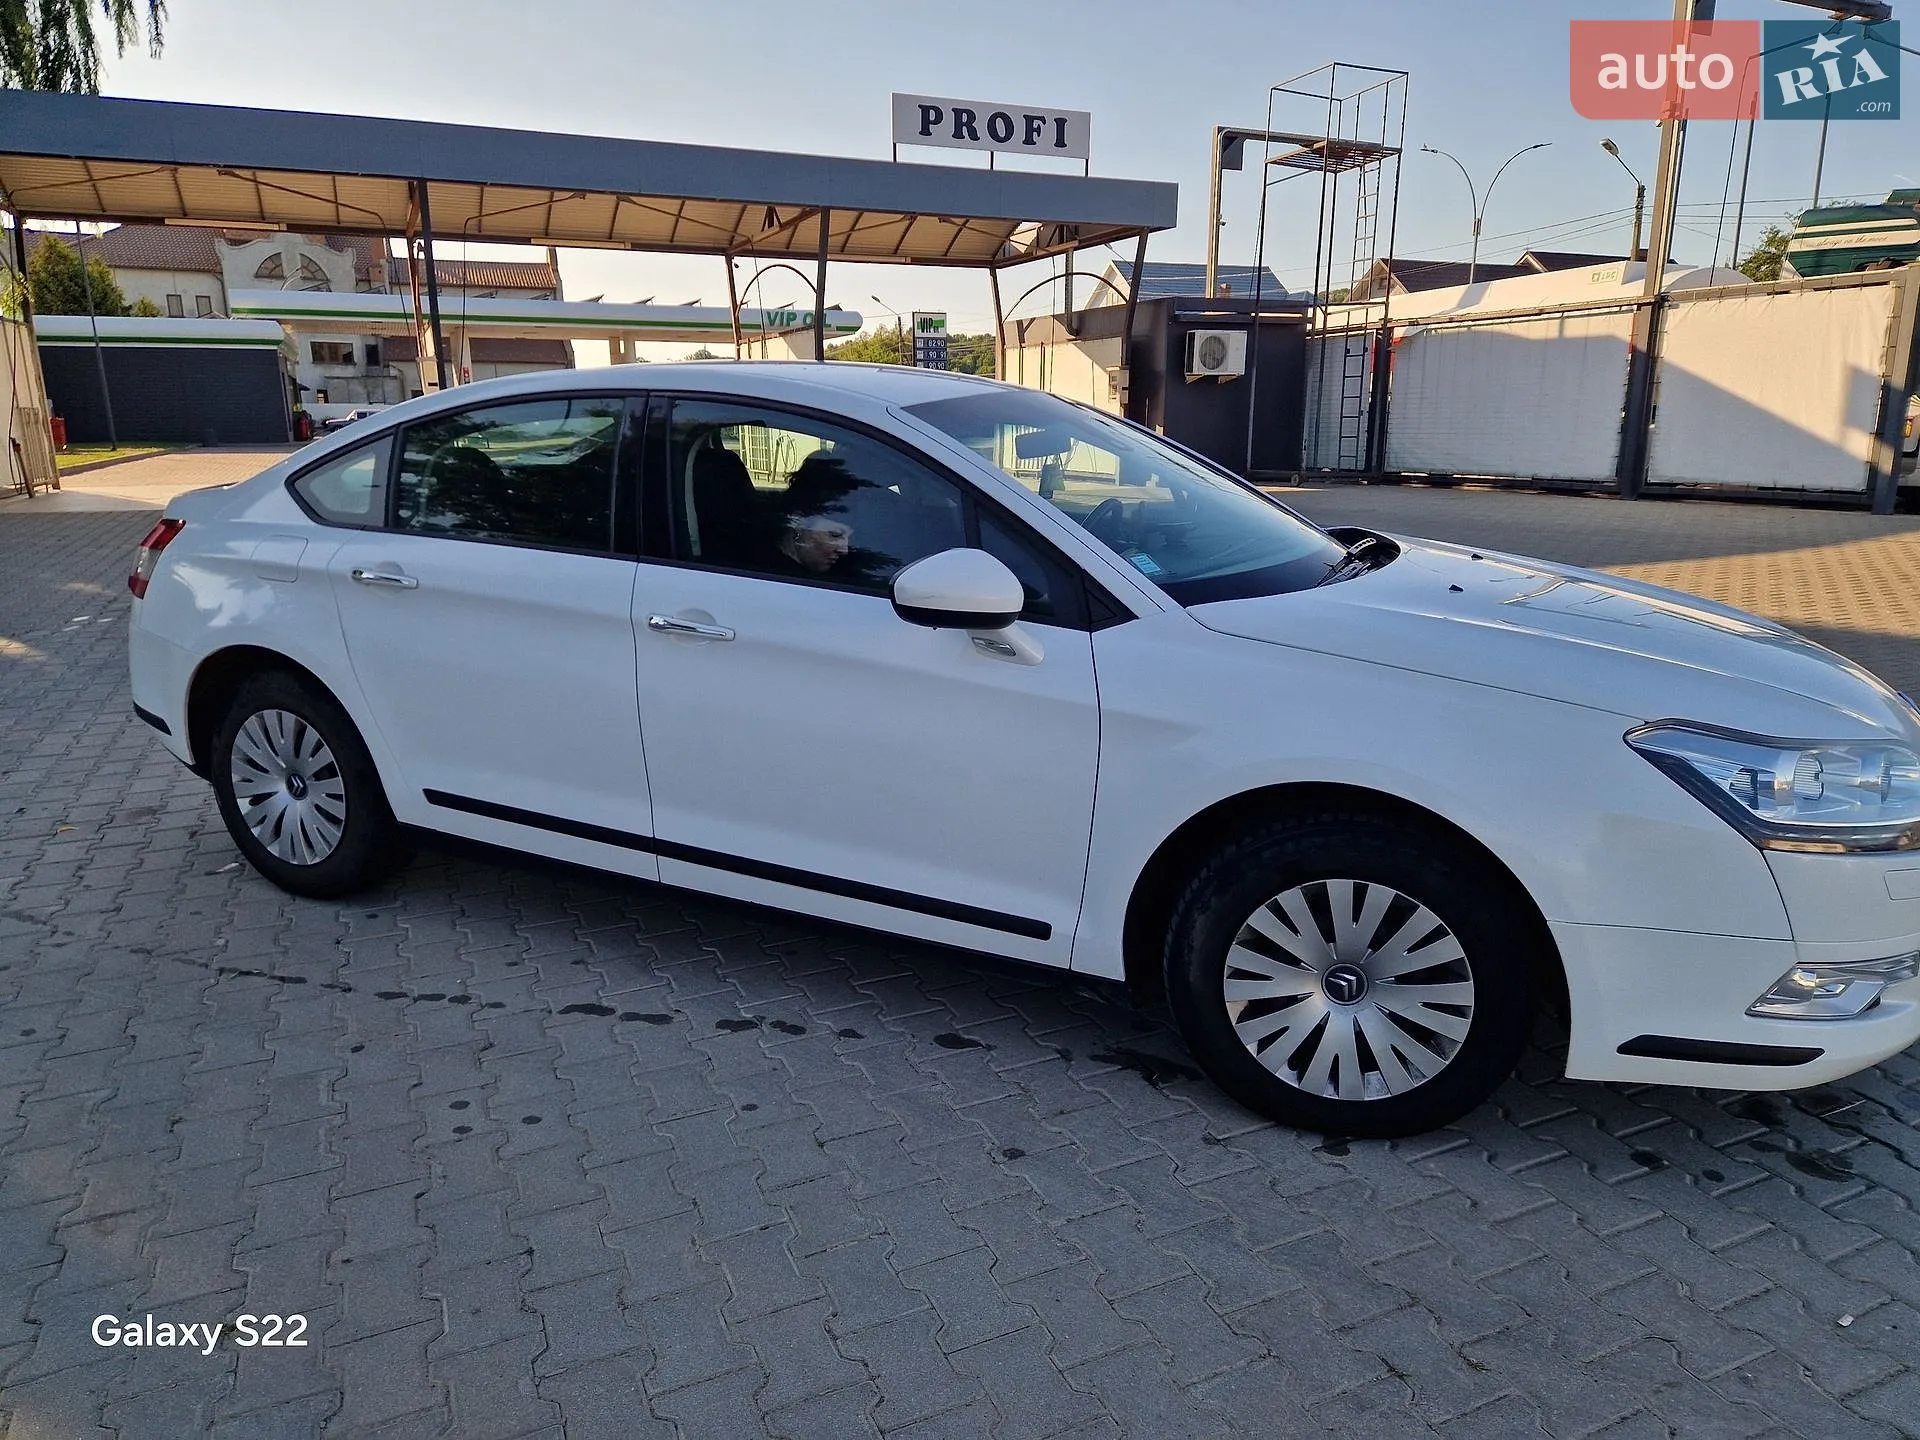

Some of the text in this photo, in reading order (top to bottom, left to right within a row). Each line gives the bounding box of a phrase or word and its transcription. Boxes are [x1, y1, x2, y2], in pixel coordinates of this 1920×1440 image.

[917, 103, 1068, 149] PROFI
[766, 311, 832, 328] VIP OL
[919, 317, 934, 333] VIP
